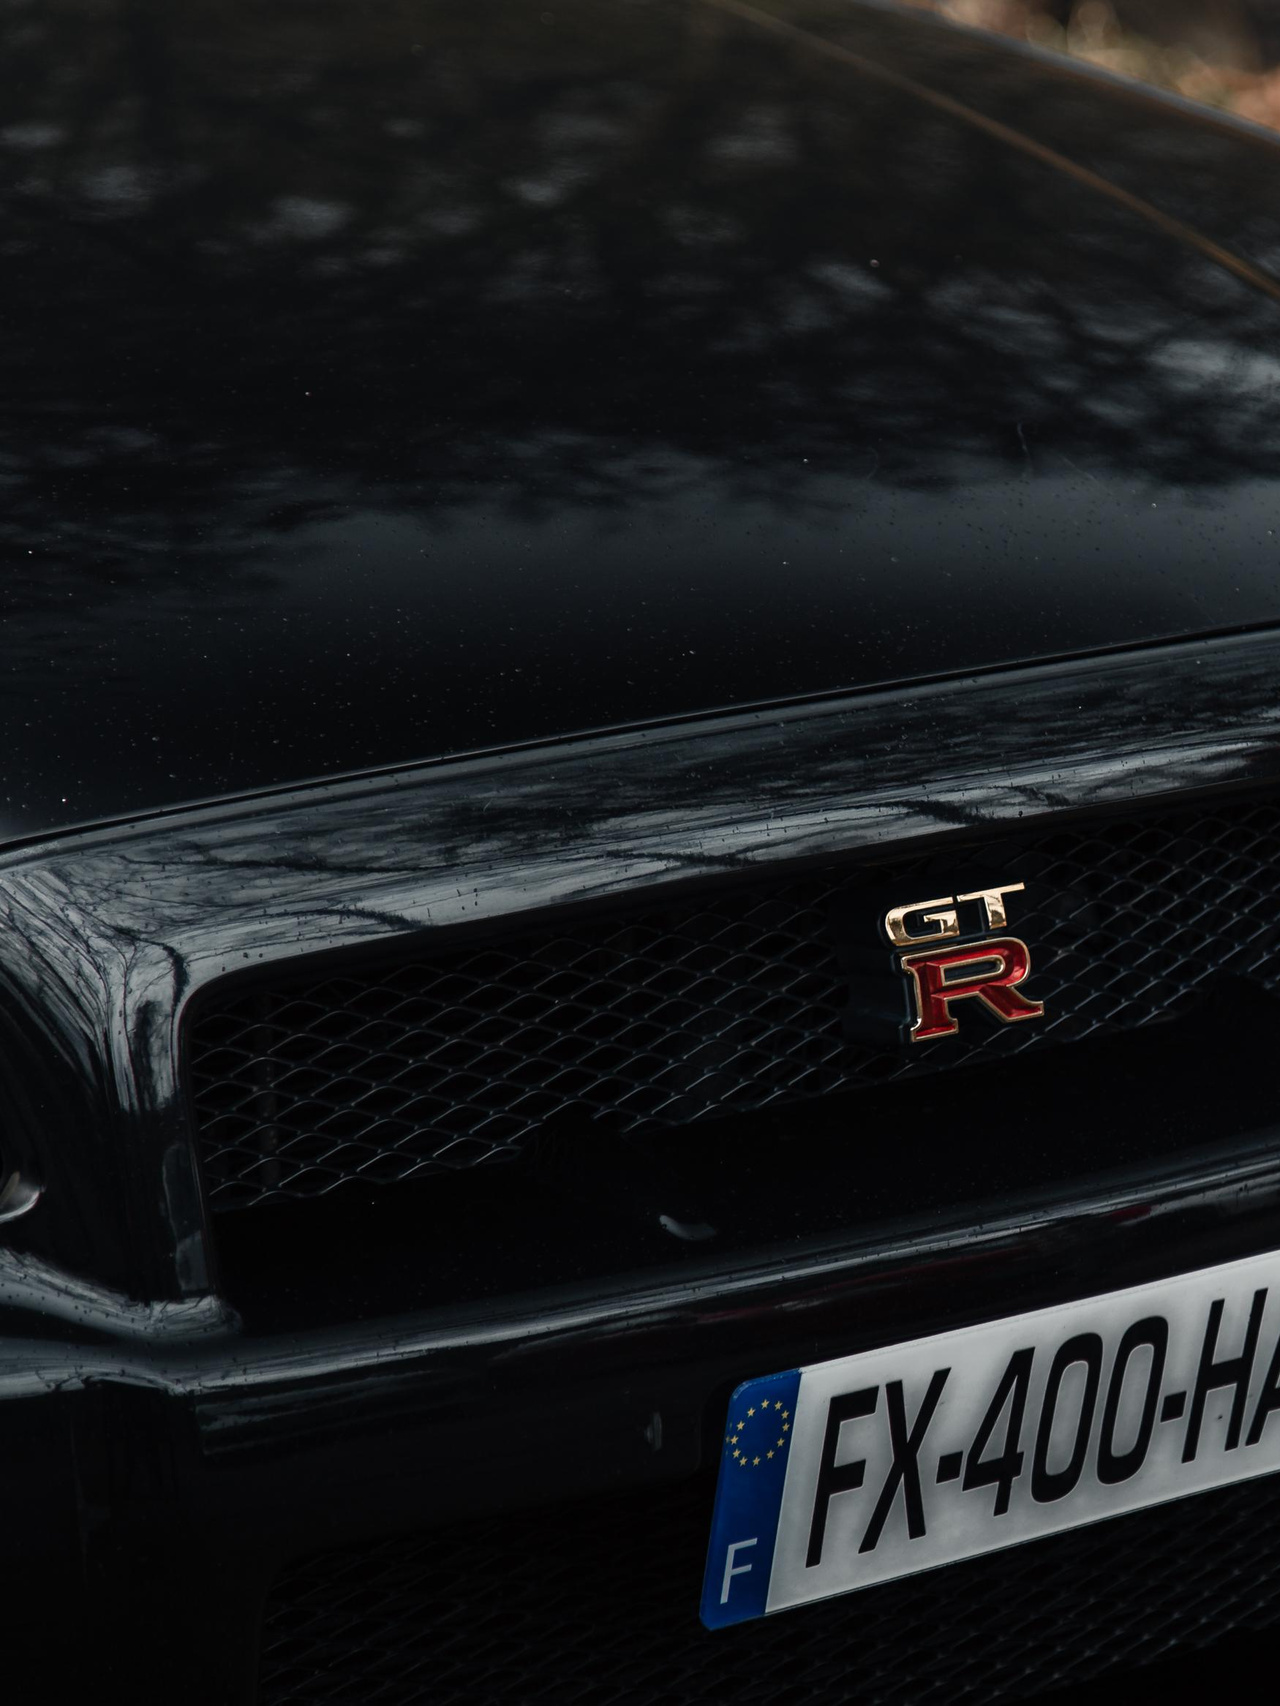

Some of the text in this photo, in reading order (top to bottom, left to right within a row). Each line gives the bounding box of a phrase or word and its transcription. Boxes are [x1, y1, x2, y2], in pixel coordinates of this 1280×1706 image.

[885, 882, 1025, 946] GT
[901, 937, 1044, 1042] R
[720, 1538, 758, 1604] F
